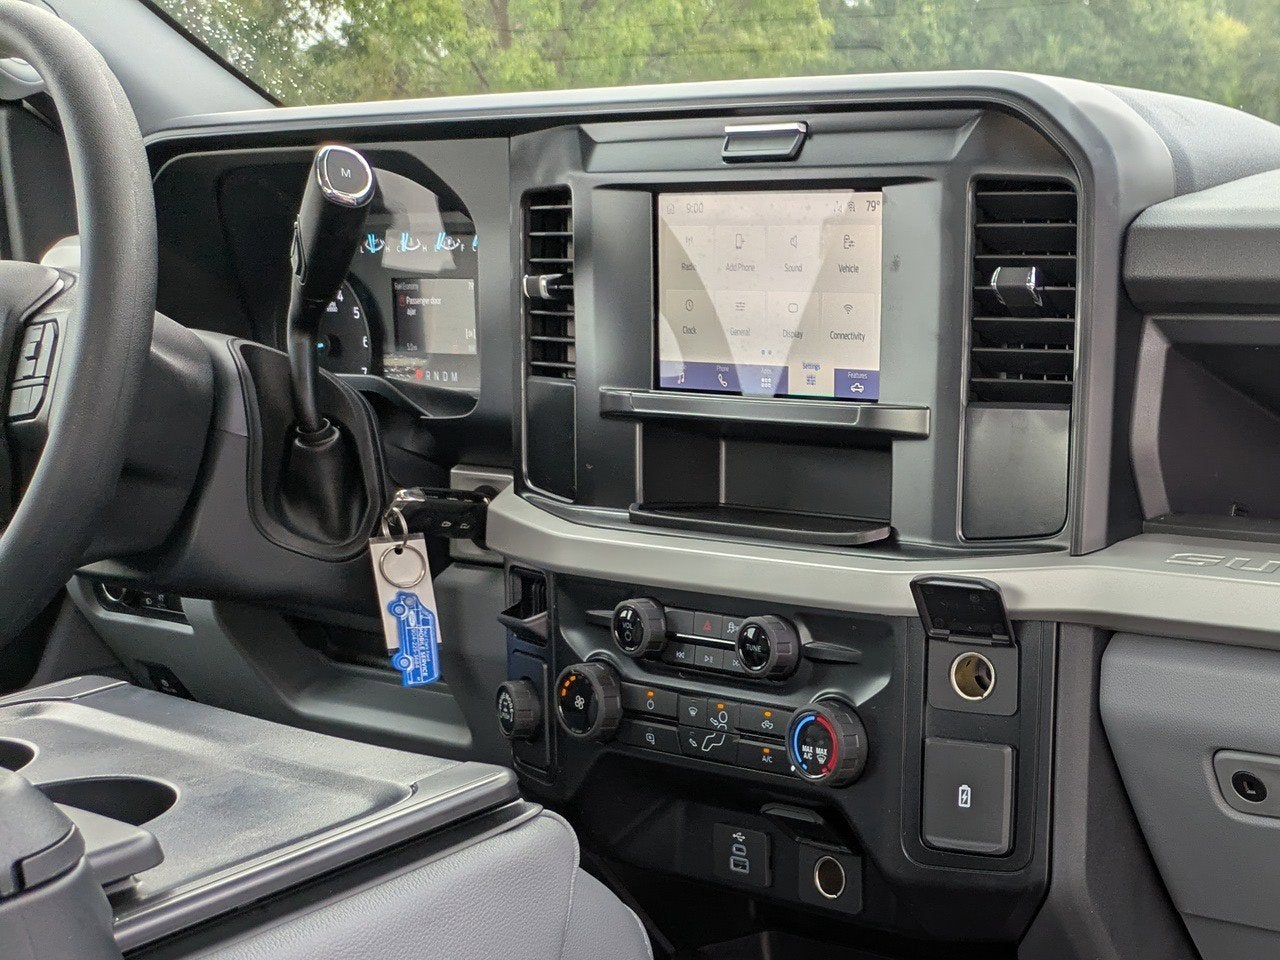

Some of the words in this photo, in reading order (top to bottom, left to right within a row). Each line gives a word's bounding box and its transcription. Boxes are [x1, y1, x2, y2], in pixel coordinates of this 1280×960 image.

[340, 167, 351, 179] M
[687, 202, 704, 213] 9:00
[726, 264, 737, 272] Add
[738, 264, 755, 272] Phone
[784, 264, 803, 273] Sound
[838, 264, 859, 274] Vehicle
[336, 290, 344, 302] 4
[353, 306, 360, 319] 5
[682, 327, 697, 335] Clock
[730, 327, 751, 337] General
[783, 329, 803, 340] Display
[830, 331, 865, 342] Connectivity
[802, 362, 821, 371] Settings
[746, 643, 762, 653] TUNE
[420, 652, 428, 677] SERVICE
[816, 747, 827, 755] MAX
